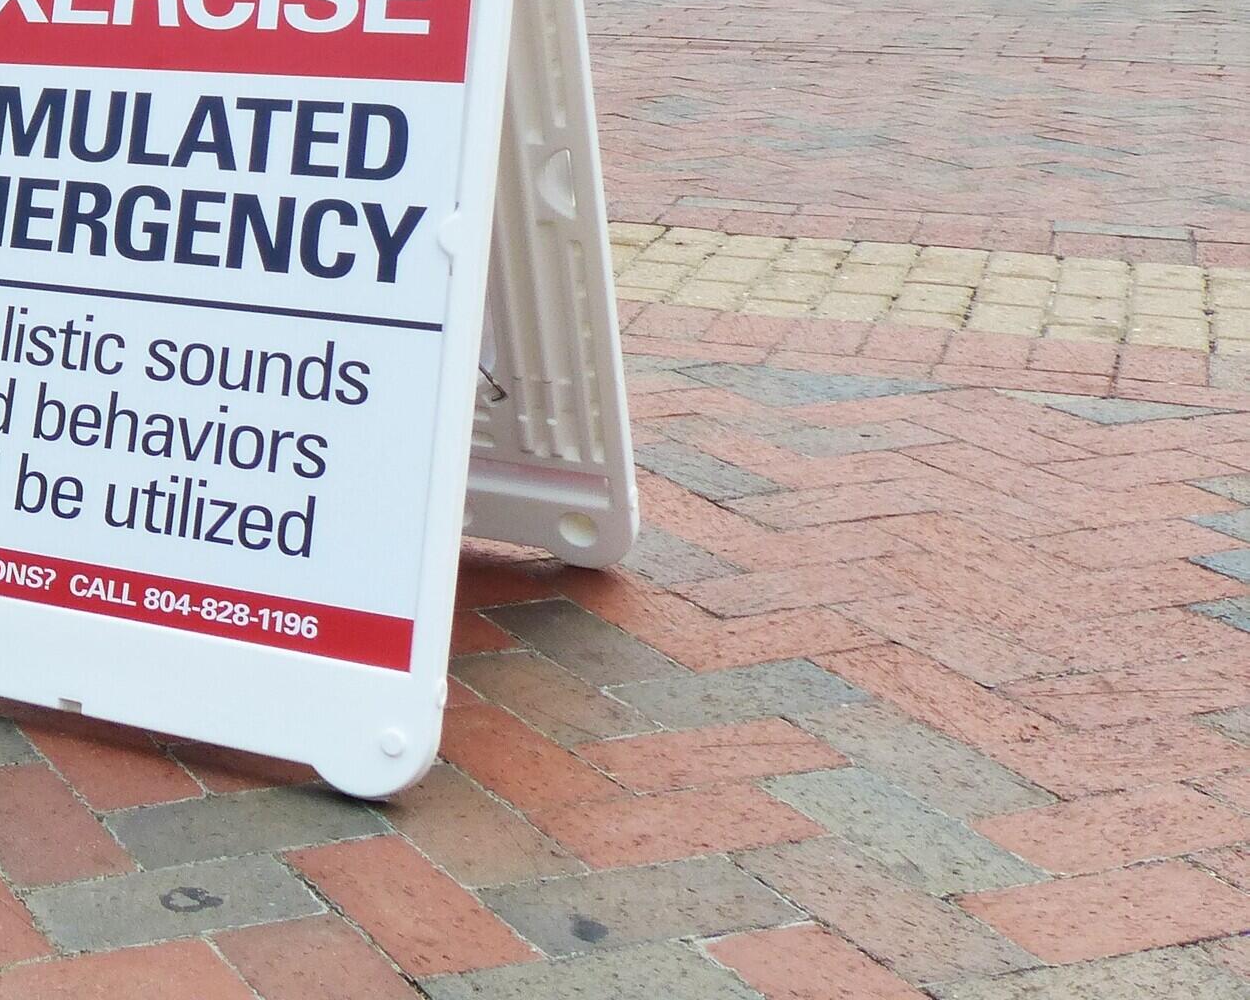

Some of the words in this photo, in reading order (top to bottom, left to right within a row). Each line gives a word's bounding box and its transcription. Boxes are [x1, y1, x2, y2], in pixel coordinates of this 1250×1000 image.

[144, 340, 371, 406] sounds
[32, 381, 329, 479] behaviors
[14, 452, 84, 520] be
[104, 474, 317, 559] utilized
[69, 574, 137, 607] CALL
[143, 587, 319, 639] 804-828-1196
